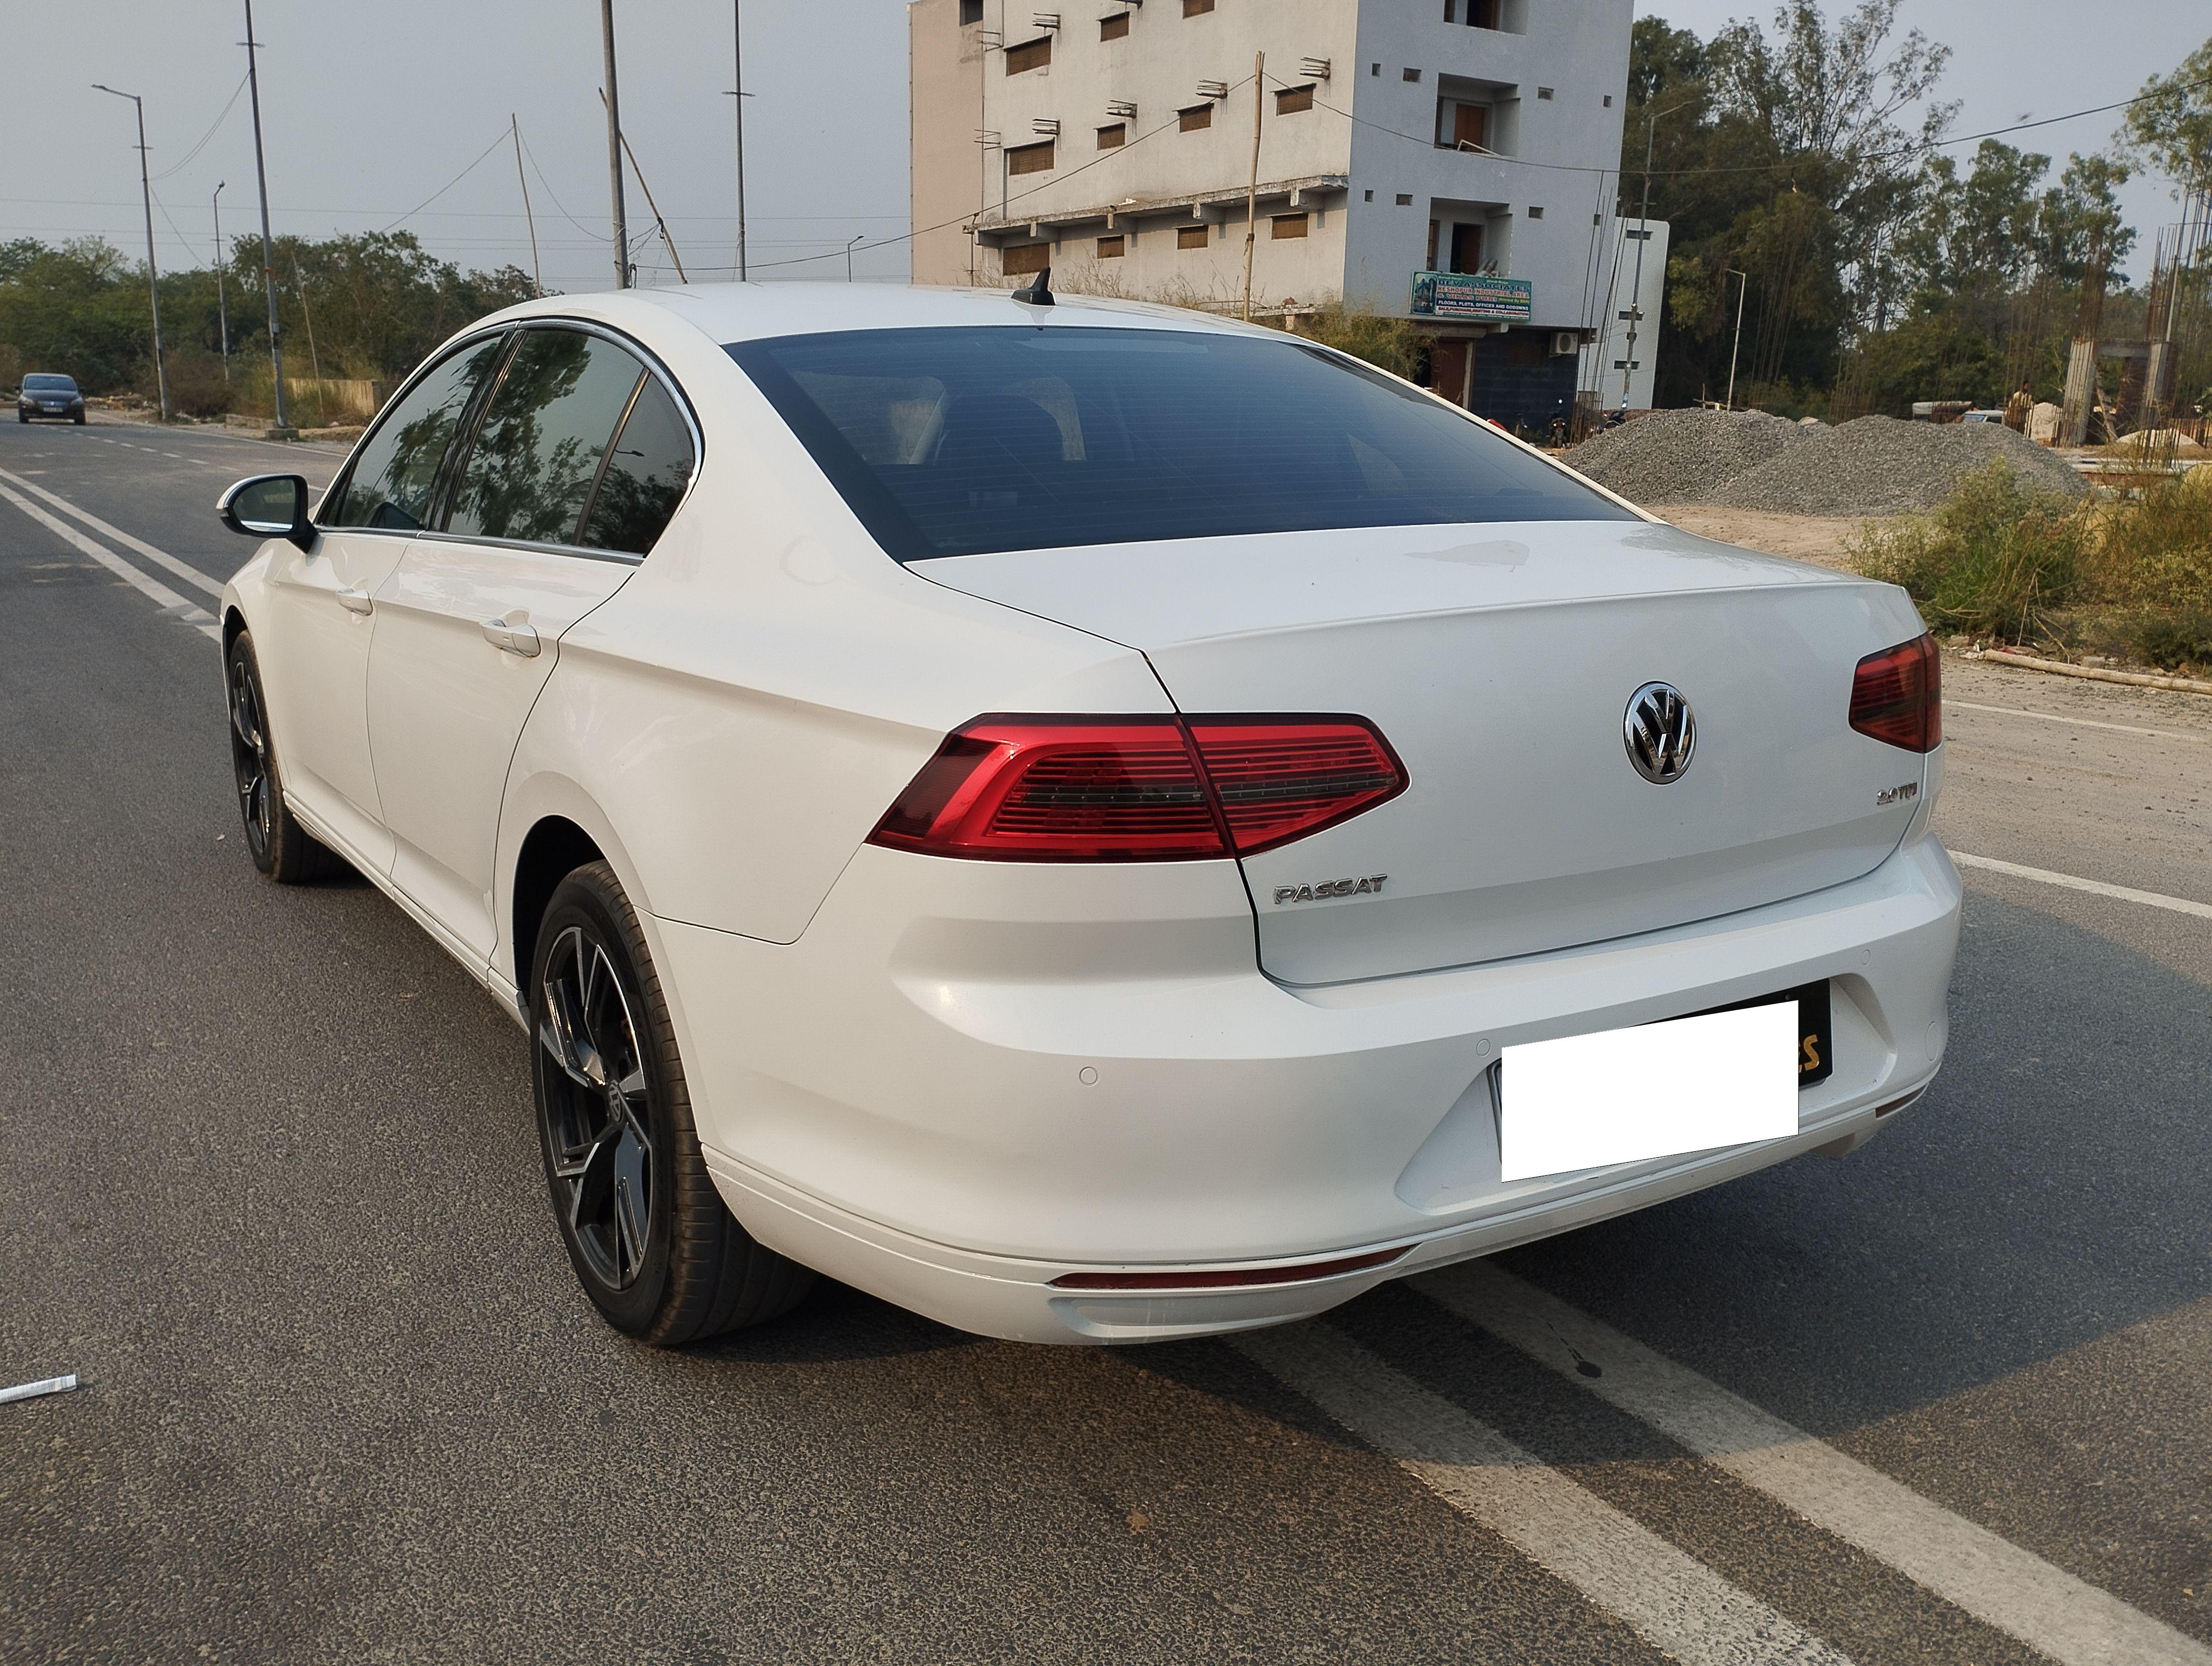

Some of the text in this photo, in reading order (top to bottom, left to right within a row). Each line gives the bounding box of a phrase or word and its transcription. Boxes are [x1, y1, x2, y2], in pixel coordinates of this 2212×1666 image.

[1463, 281, 1530, 291] ASSOCIATES
[1474, 288, 1510, 297] INDUSTRIAL
[1274, 873, 1387, 904] PASSAT
